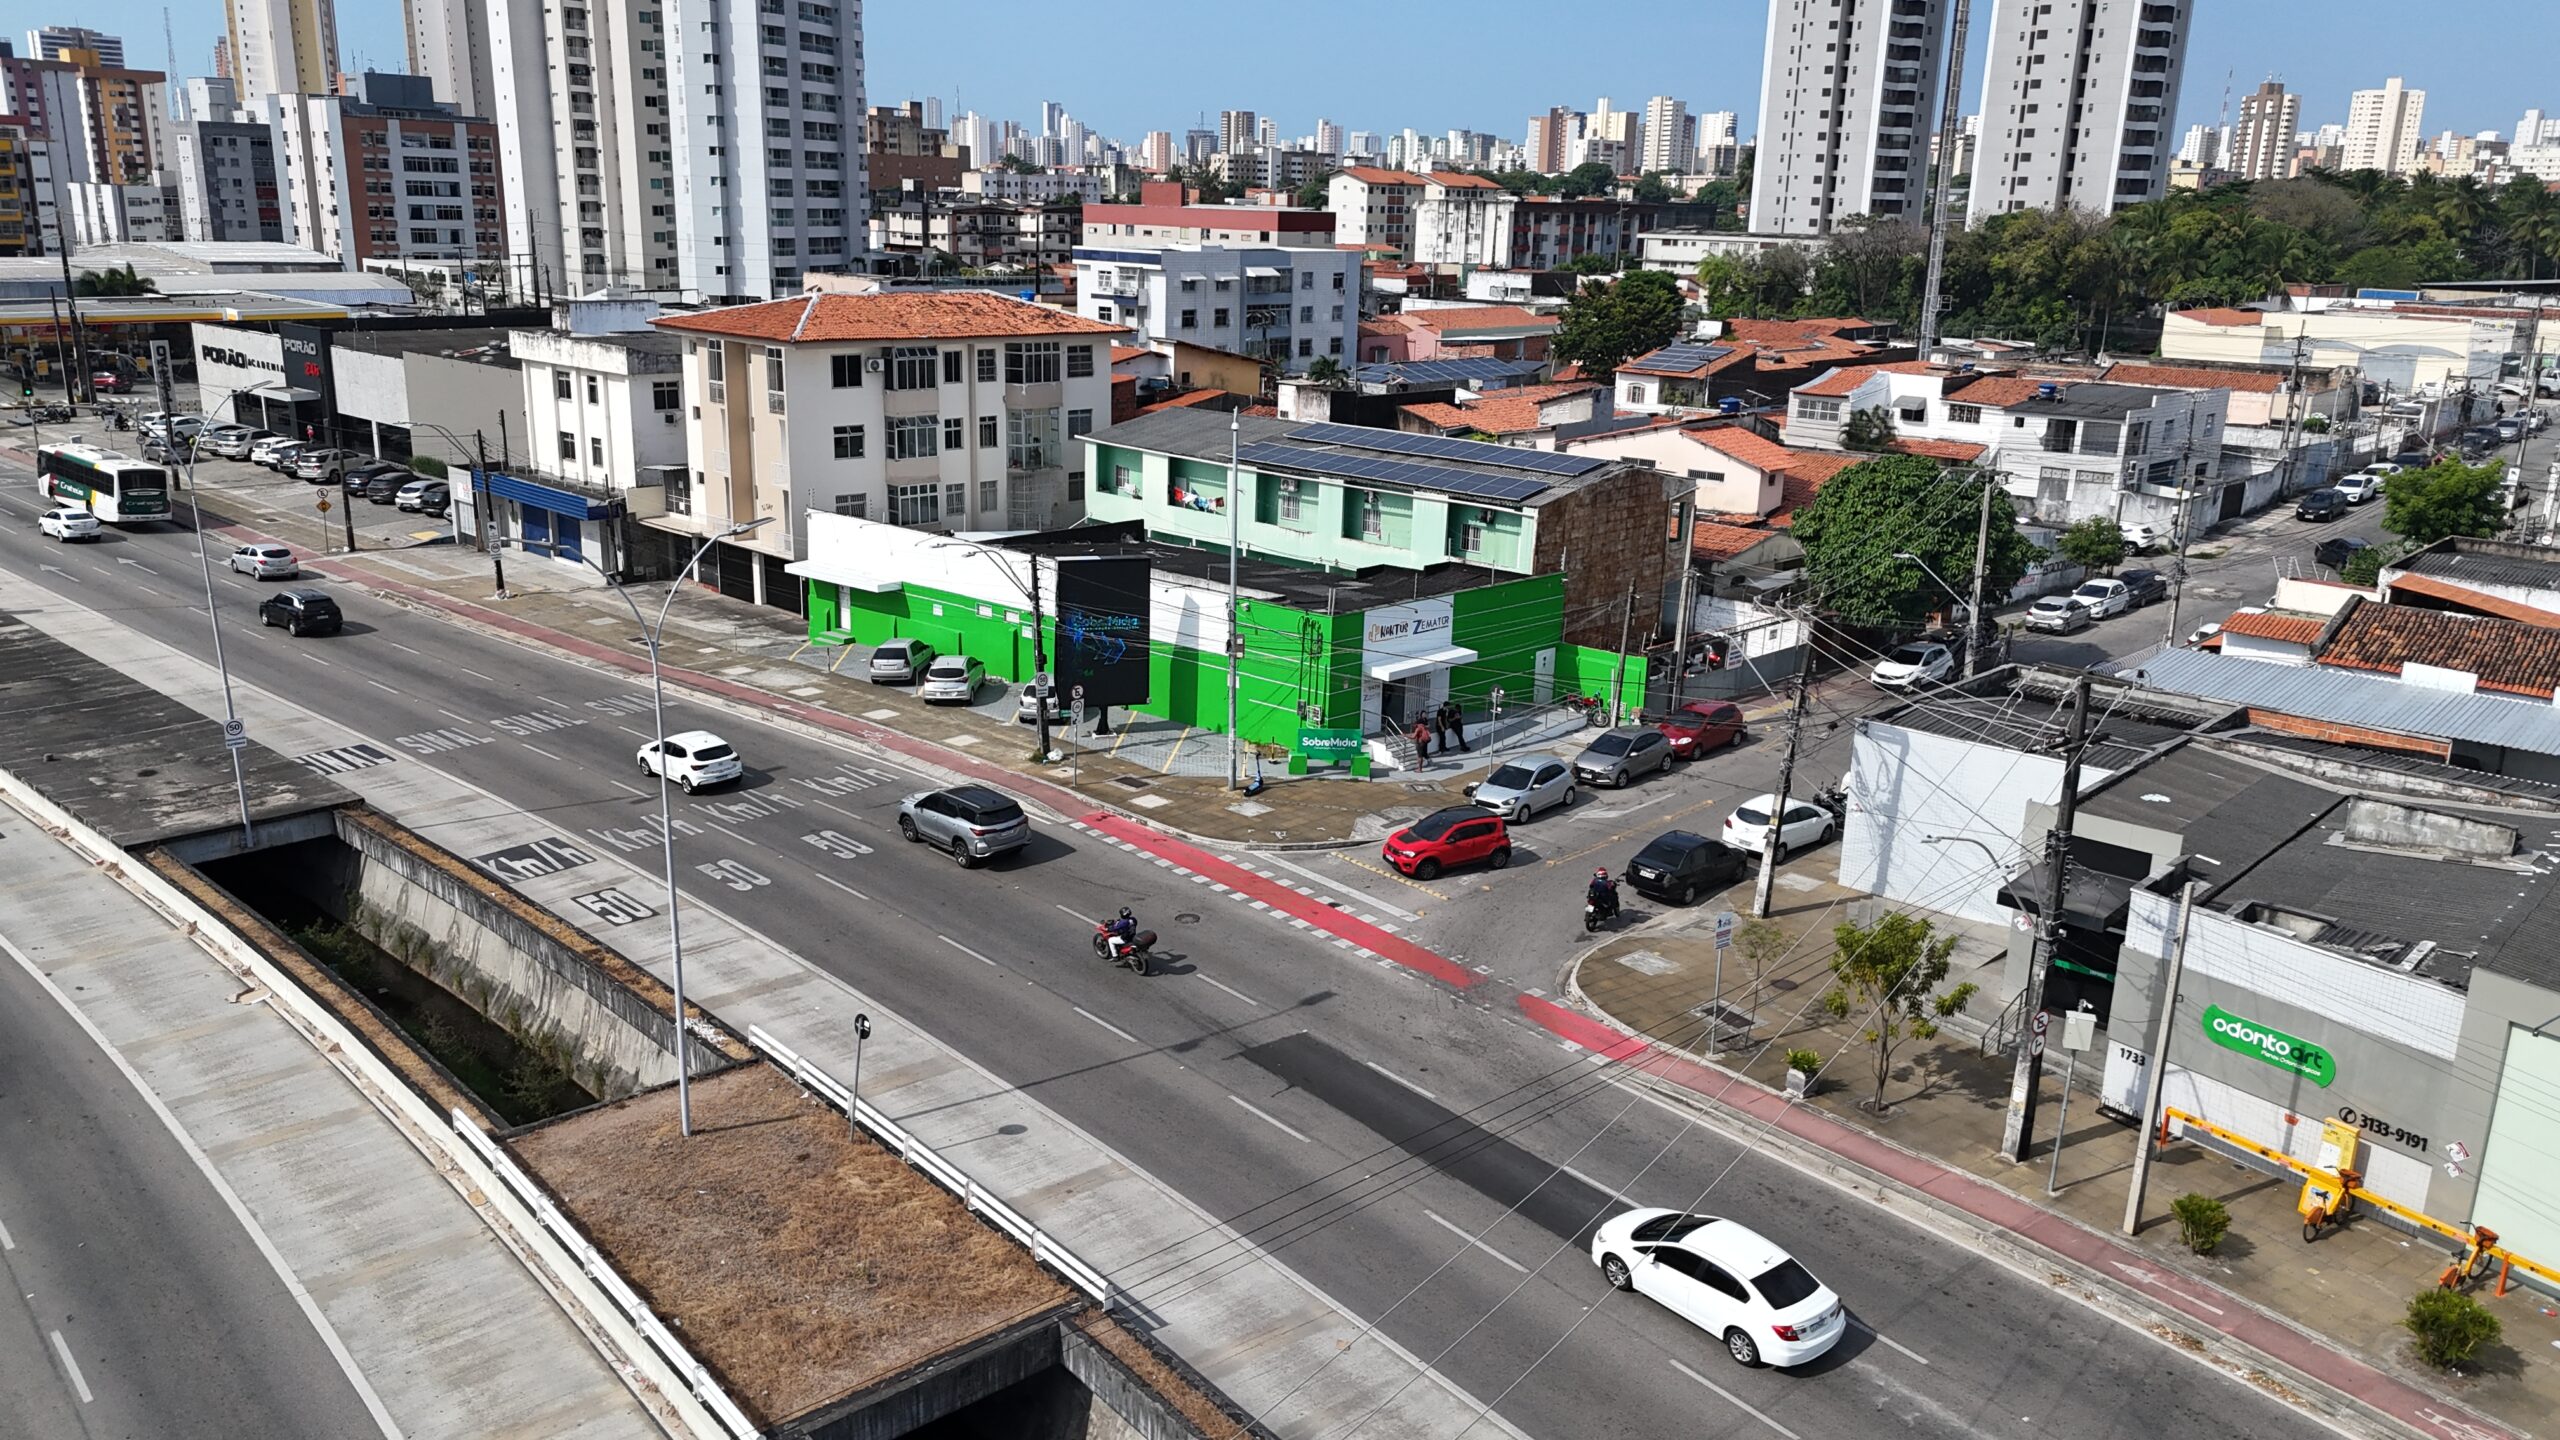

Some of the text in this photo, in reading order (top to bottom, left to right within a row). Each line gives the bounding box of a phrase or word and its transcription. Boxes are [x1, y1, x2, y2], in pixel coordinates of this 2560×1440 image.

[201, 344, 285, 373] PORÃO ACADEMIA
[283, 338, 317, 356] PORÃO
[1412, 615, 1450, 635] ZEMATOR
[584, 692, 679, 717] SINAL
[229, 723, 241, 732] 50
[490, 709, 589, 736] SINAL
[395, 727, 497, 755] SINAL
[789, 764, 901, 797] Km/h
[689, 788, 805, 824] Km/h
[586, 813, 704, 851] Km/h
[800, 829, 875, 860] 50
[472, 840, 595, 884] Km/h
[694, 858, 772, 891] 50
[577, 889, 654, 924] 50
[2120, 1047, 2146, 1066] 1733
[2212, 1017, 2323, 1070] odontoart
[2358, 1113, 2429, 1152] 3133-9191
